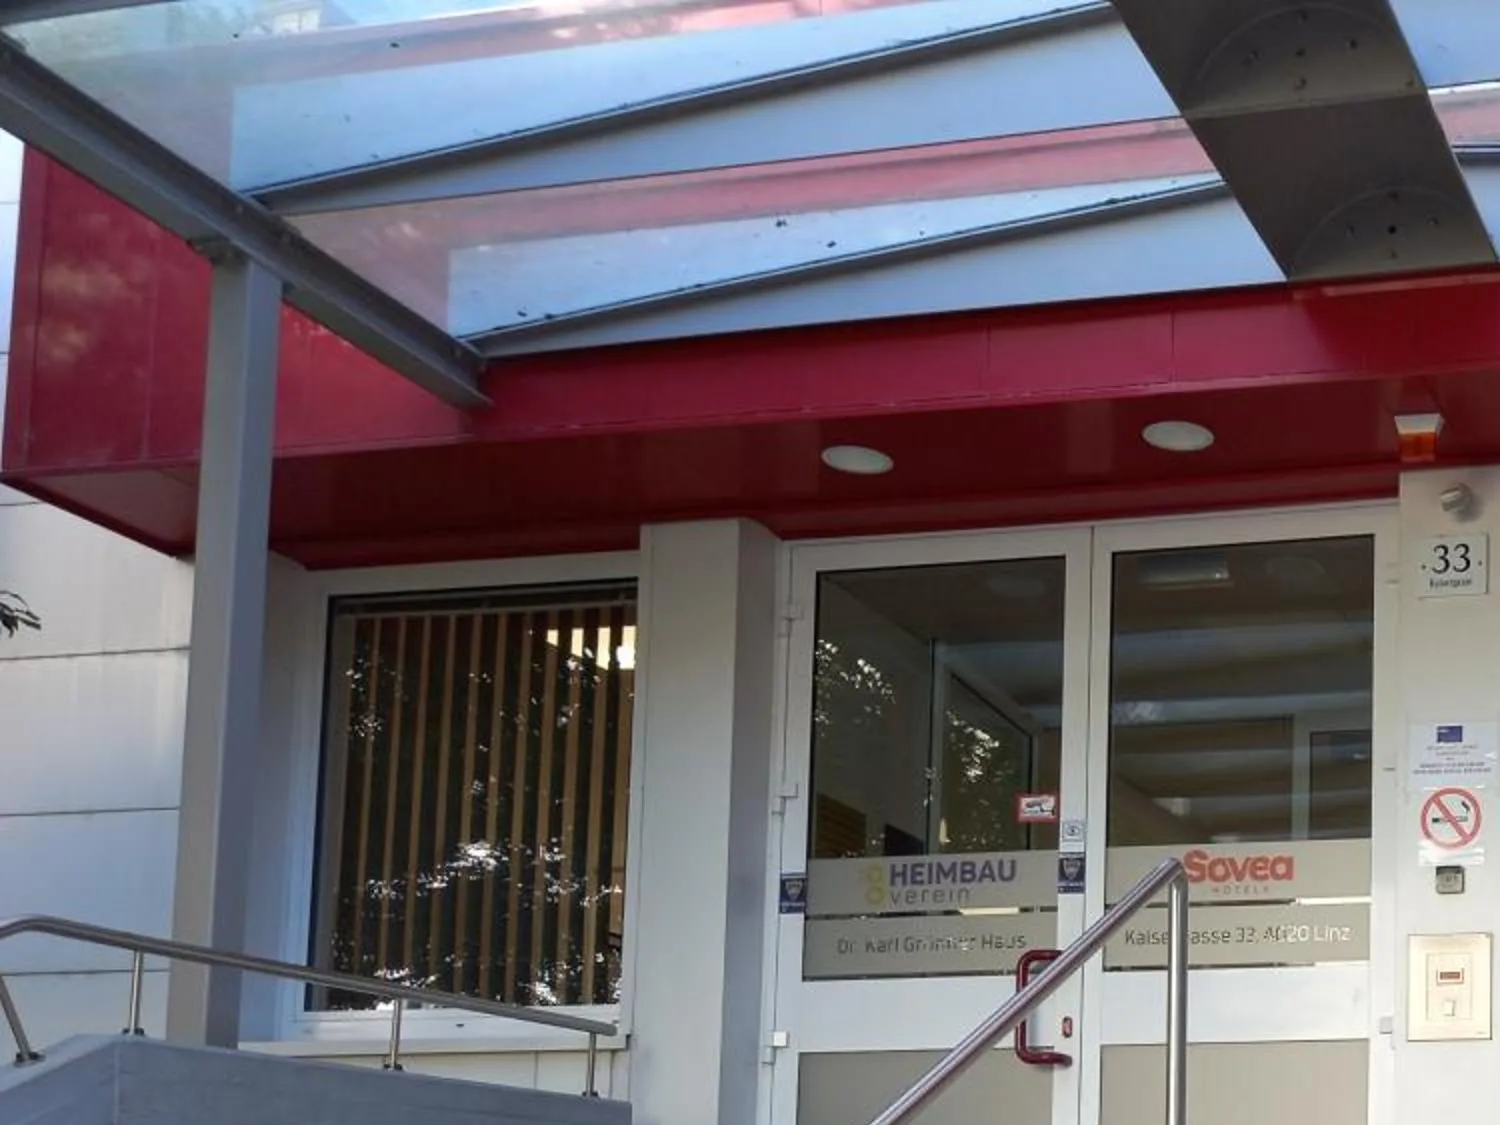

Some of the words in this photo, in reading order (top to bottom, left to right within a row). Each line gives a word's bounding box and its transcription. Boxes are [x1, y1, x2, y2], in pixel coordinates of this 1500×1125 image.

[1431, 543, 1472, 575] 33
[889, 858, 1017, 886] HEIMBAU
[1182, 848, 1295, 884] Sovea
[889, 886, 971, 905] verein
[864, 936, 899, 952] Karl
[1124, 928, 1231, 946] Kaiseasse
[1313, 923, 1352, 943] Linz
